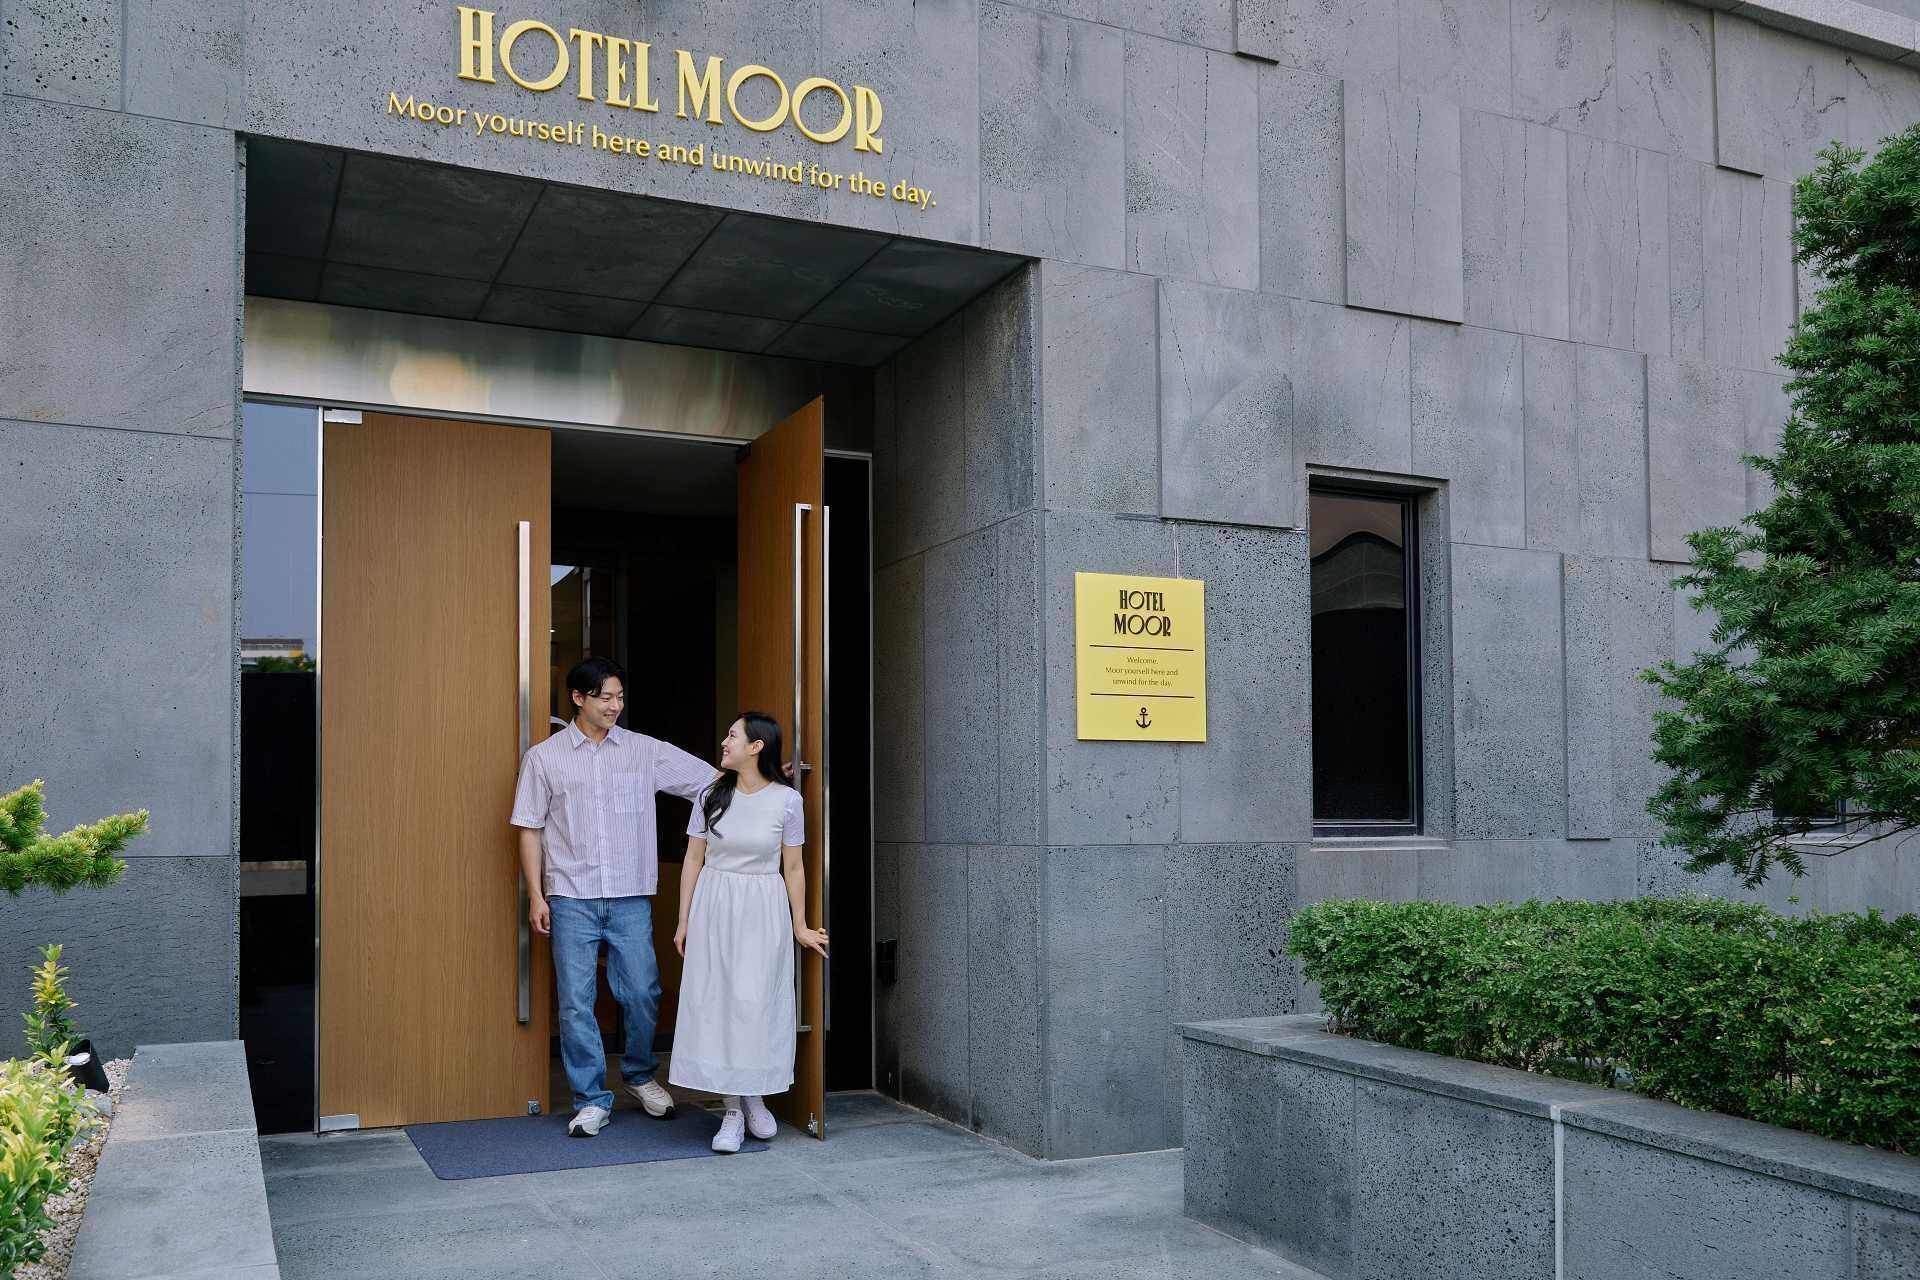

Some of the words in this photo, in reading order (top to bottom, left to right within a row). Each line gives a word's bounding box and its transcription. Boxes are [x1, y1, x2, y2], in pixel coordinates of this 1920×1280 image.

[456, 6, 659, 113] HOTEL
[674, 49, 884, 155] MOOR
[387, 91, 468, 126] Moor
[474, 111, 585, 146] yourself
[591, 124, 650, 158] here
[657, 143, 705, 167] and
[711, 151, 804, 185] unwind
[809, 163, 844, 191] for
[849, 171, 887, 198] the
[891, 179, 937, 211] day.
[1119, 590, 1166, 612] HOTEL
[1114, 613, 1172, 637] MOOR
[1105, 666, 1123, 674] Moor
[1124, 667, 1150, 676] yourself
[1150, 668, 1166, 676] here
[1166, 668, 1179, 676] and
[1112, 678, 1137, 686] unwind
[1138, 678, 1148, 686] for
[1148, 678, 1159, 686] the
